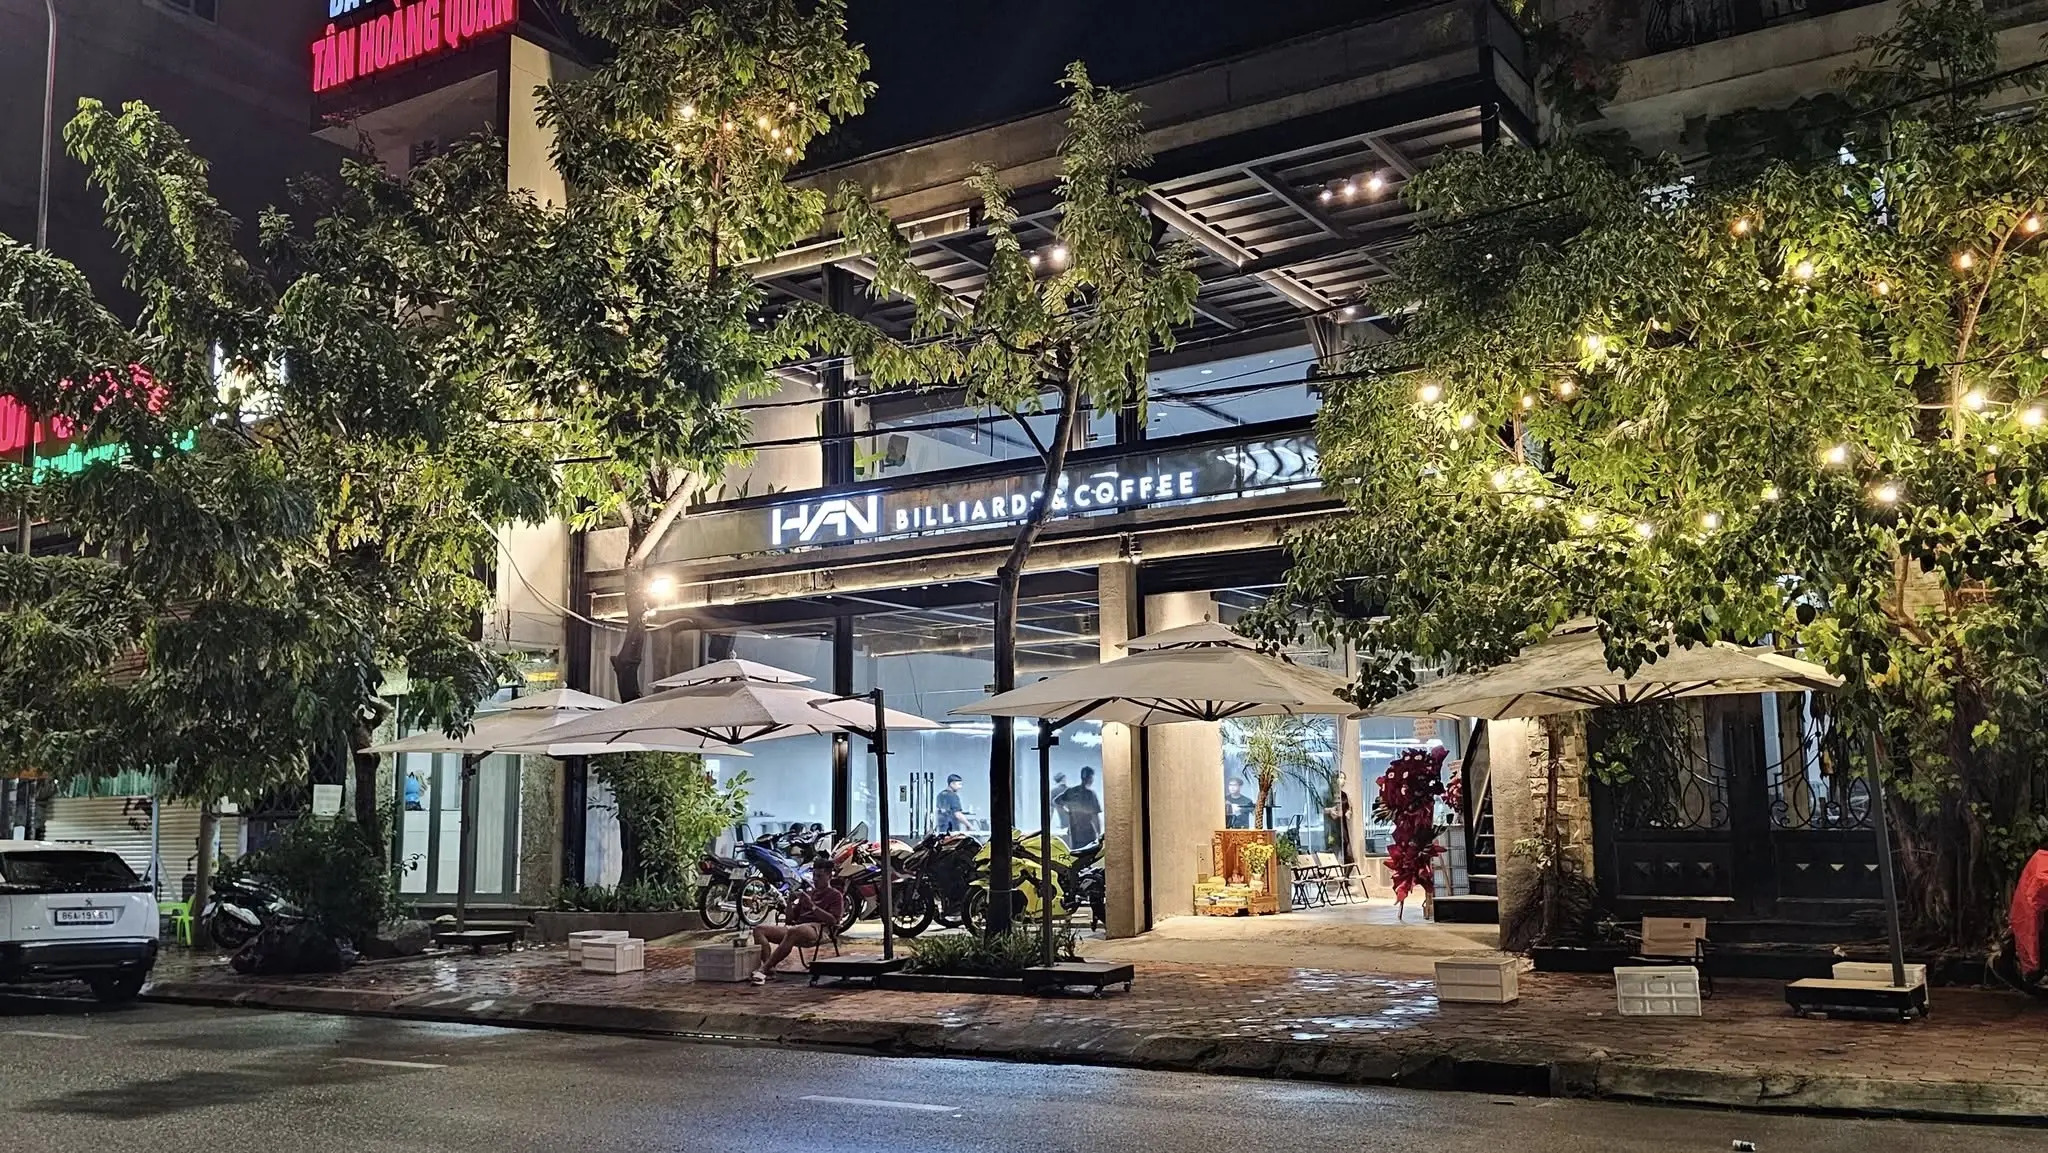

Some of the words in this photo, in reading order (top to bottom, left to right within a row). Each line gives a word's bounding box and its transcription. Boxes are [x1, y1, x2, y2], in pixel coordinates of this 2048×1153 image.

[312, 23, 355, 92] TÂN
[358, 0, 440, 76] HOÀNG
[771, 495, 878, 545] HAN
[1073, 471, 1194, 507] COFFEE
